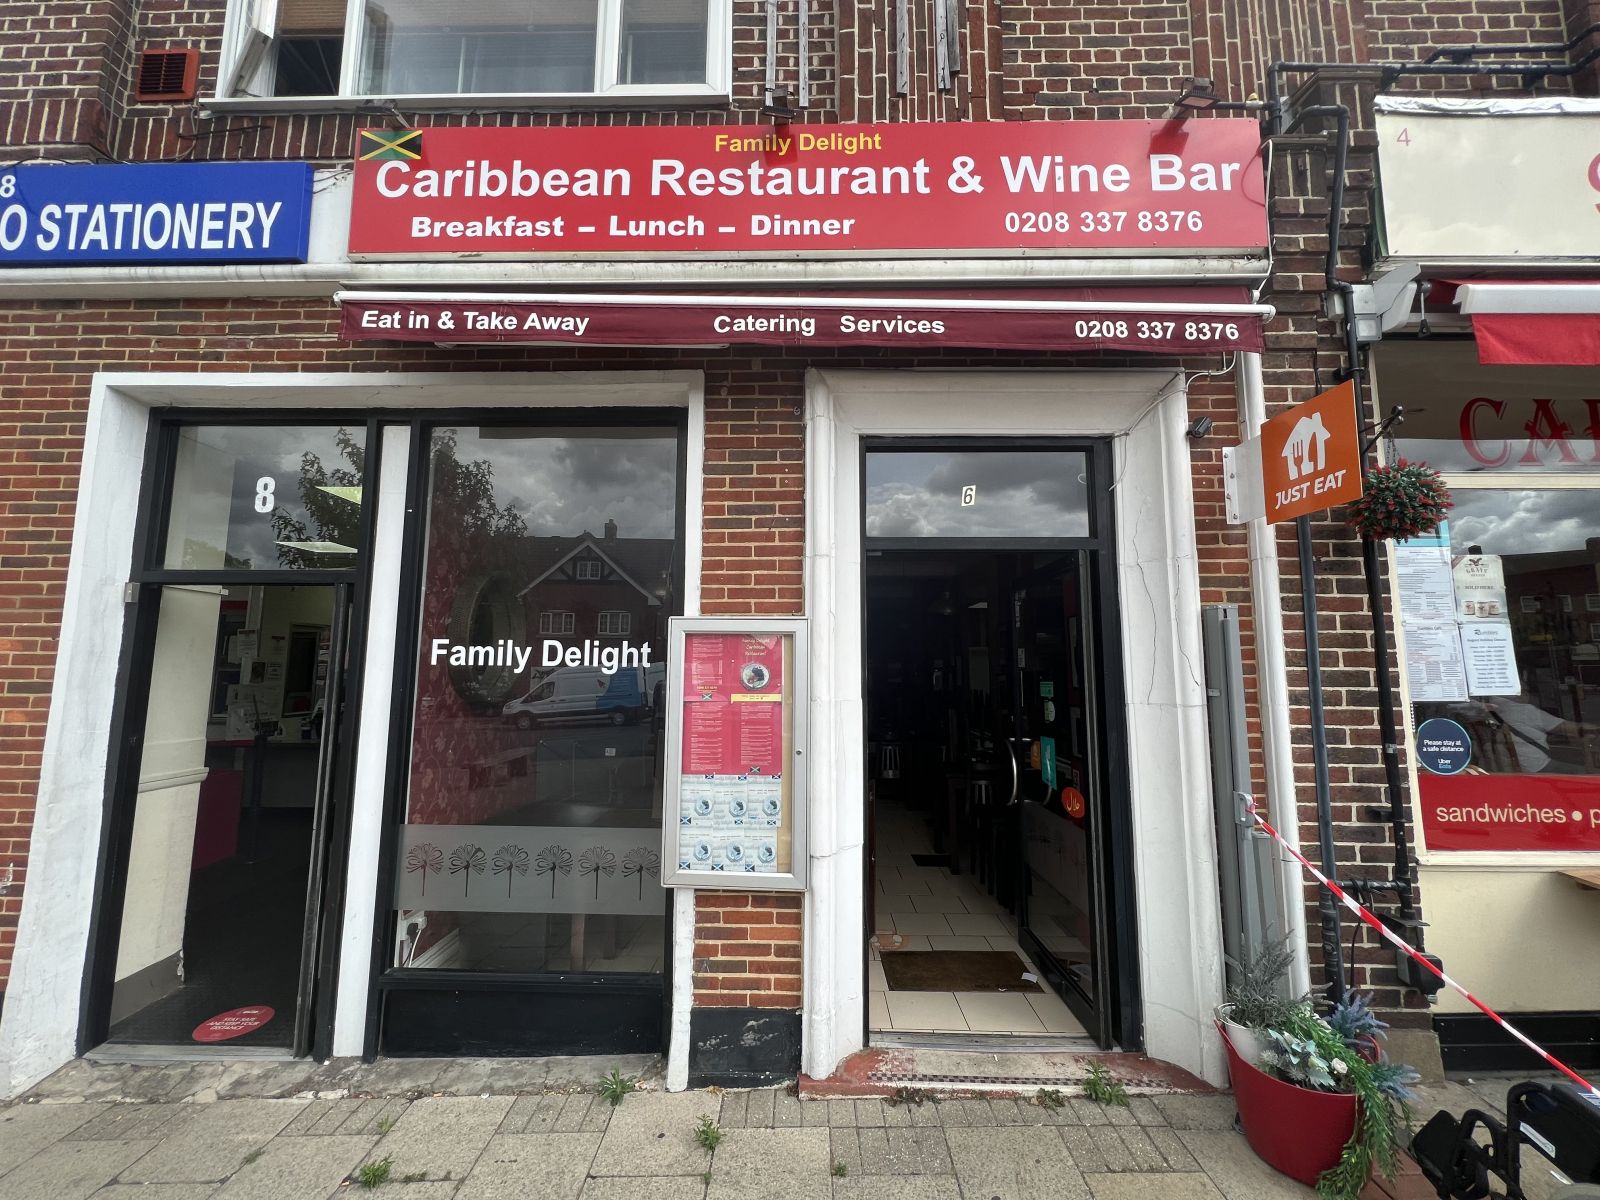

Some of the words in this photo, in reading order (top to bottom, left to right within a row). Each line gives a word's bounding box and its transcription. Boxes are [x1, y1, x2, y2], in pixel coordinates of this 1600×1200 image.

[715, 134, 792, 156] Family
[799, 132, 882, 155] Delight
[1397, 127, 1411, 147] 4
[376, 157, 631, 198] Caribbean
[651, 157, 931, 197] Restaurant
[947, 155, 985, 194] &
[1000, 155, 1132, 193] Wine
[1149, 154, 1241, 192] Bar
[36, 201, 283, 251] STATIONERY
[411, 215, 565, 238] Breakfast
[609, 214, 705, 237] Lunch
[751, 214, 856, 236] Dinner
[1004, 211, 1070, 233] 0208
[1079, 210, 1128, 233] 337
[1137, 209, 1203, 233] 8376
[361, 310, 402, 329] Eat
[408, 310, 430, 329] in
[437, 310, 456, 330] &
[463, 311, 518, 330] Take
[523, 312, 590, 336] Away
[713, 313, 816, 337] Catering
[839, 314, 945, 334] Services
[1075, 320, 1129, 339] 0208
[1136, 321, 1176, 340] 337
[1184, 321, 1240, 341] 8376
[254, 476, 276, 514] 8
[963, 487, 974, 505] 6
[1275, 482, 1311, 510] JUST
[1314, 469, 1347, 495] EAT
[430, 638, 533, 674] Family
[541, 639, 652, 675] Delight
[1436, 802, 1567, 824] sandwiches
